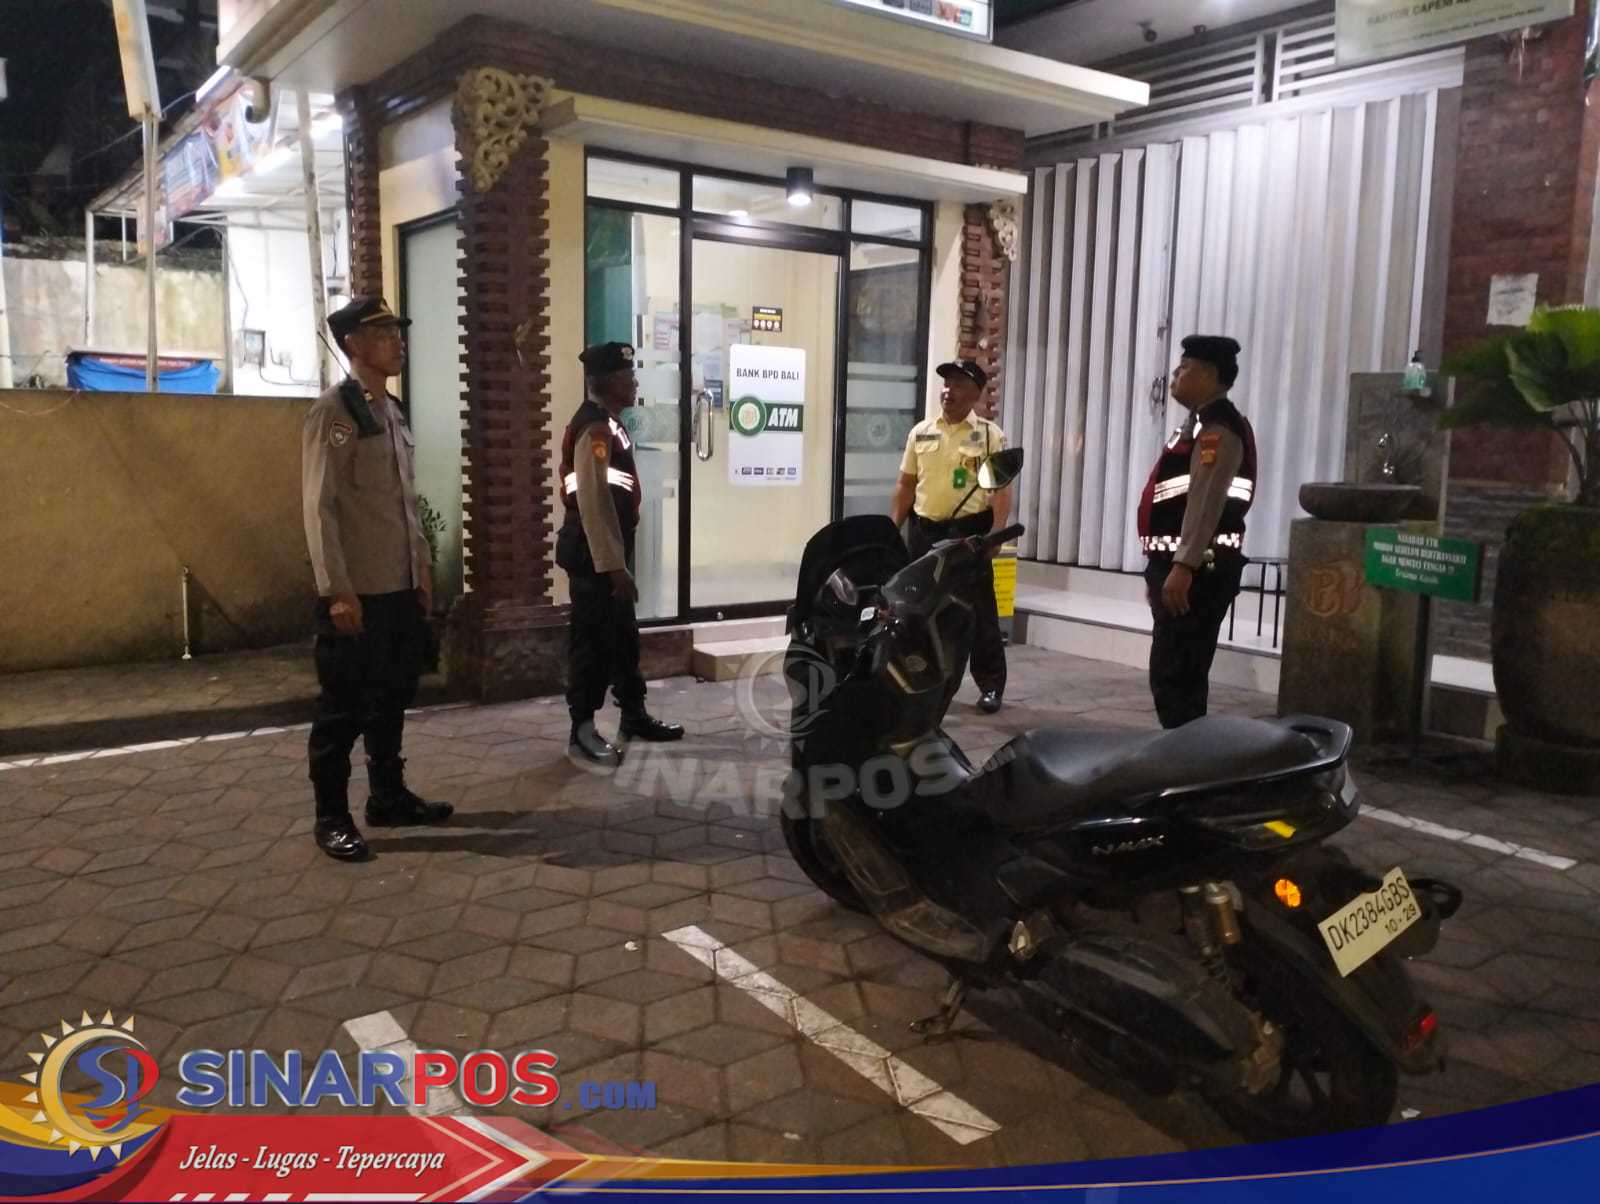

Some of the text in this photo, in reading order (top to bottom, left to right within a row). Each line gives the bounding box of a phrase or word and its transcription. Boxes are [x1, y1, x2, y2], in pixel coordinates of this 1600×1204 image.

[736, 367, 799, 381] BANK BPD BALI
[767, 407, 799, 428] ATM
[1327, 876, 1410, 951] DK2384GBS
